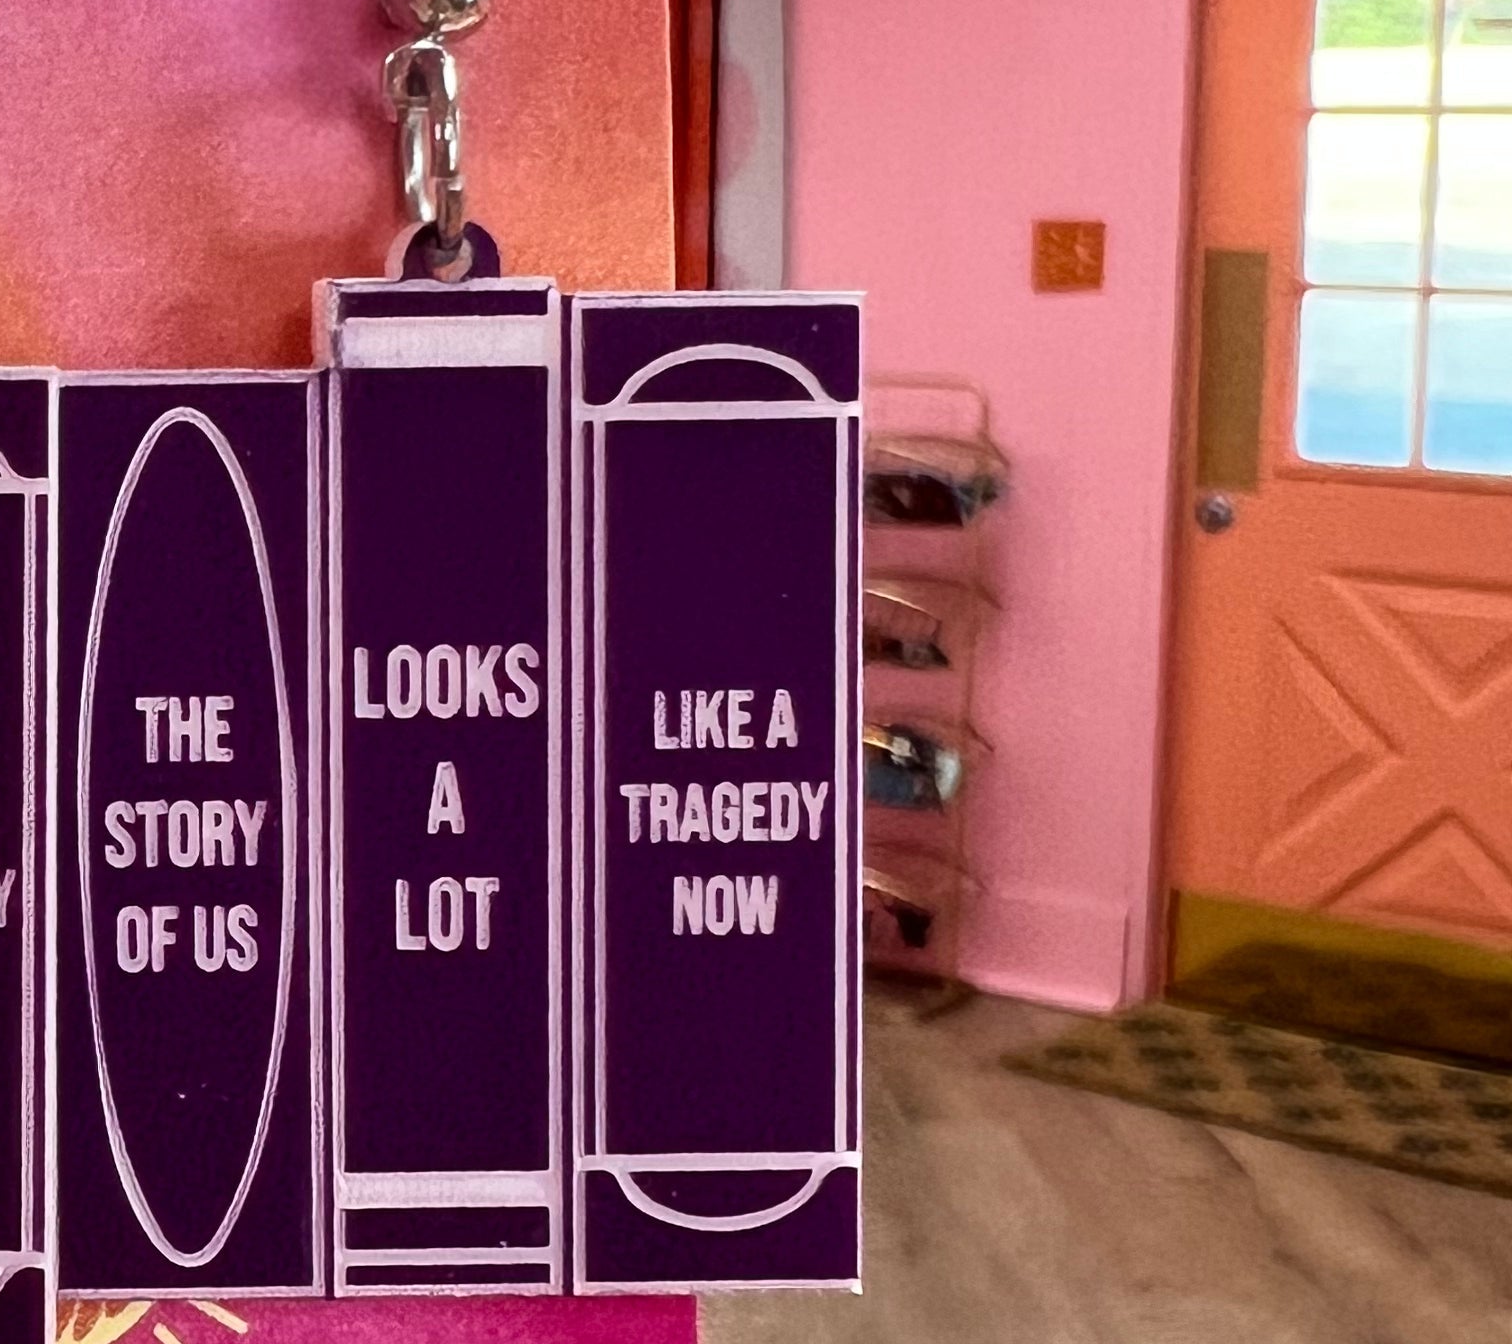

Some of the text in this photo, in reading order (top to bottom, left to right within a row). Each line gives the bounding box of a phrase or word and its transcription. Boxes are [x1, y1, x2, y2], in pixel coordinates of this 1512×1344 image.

[353, 642, 540, 720] LOOKS
[135, 695, 235, 764] THE
[653, 688, 799, 750] LIKE A
[104, 798, 267, 869] STORY
[427, 761, 466, 835] A
[619, 781, 829, 844] TRAGEDY
[116, 903, 259, 974] OF US
[395, 876, 500, 952] LOT
[672, 874, 779, 936] NOW
